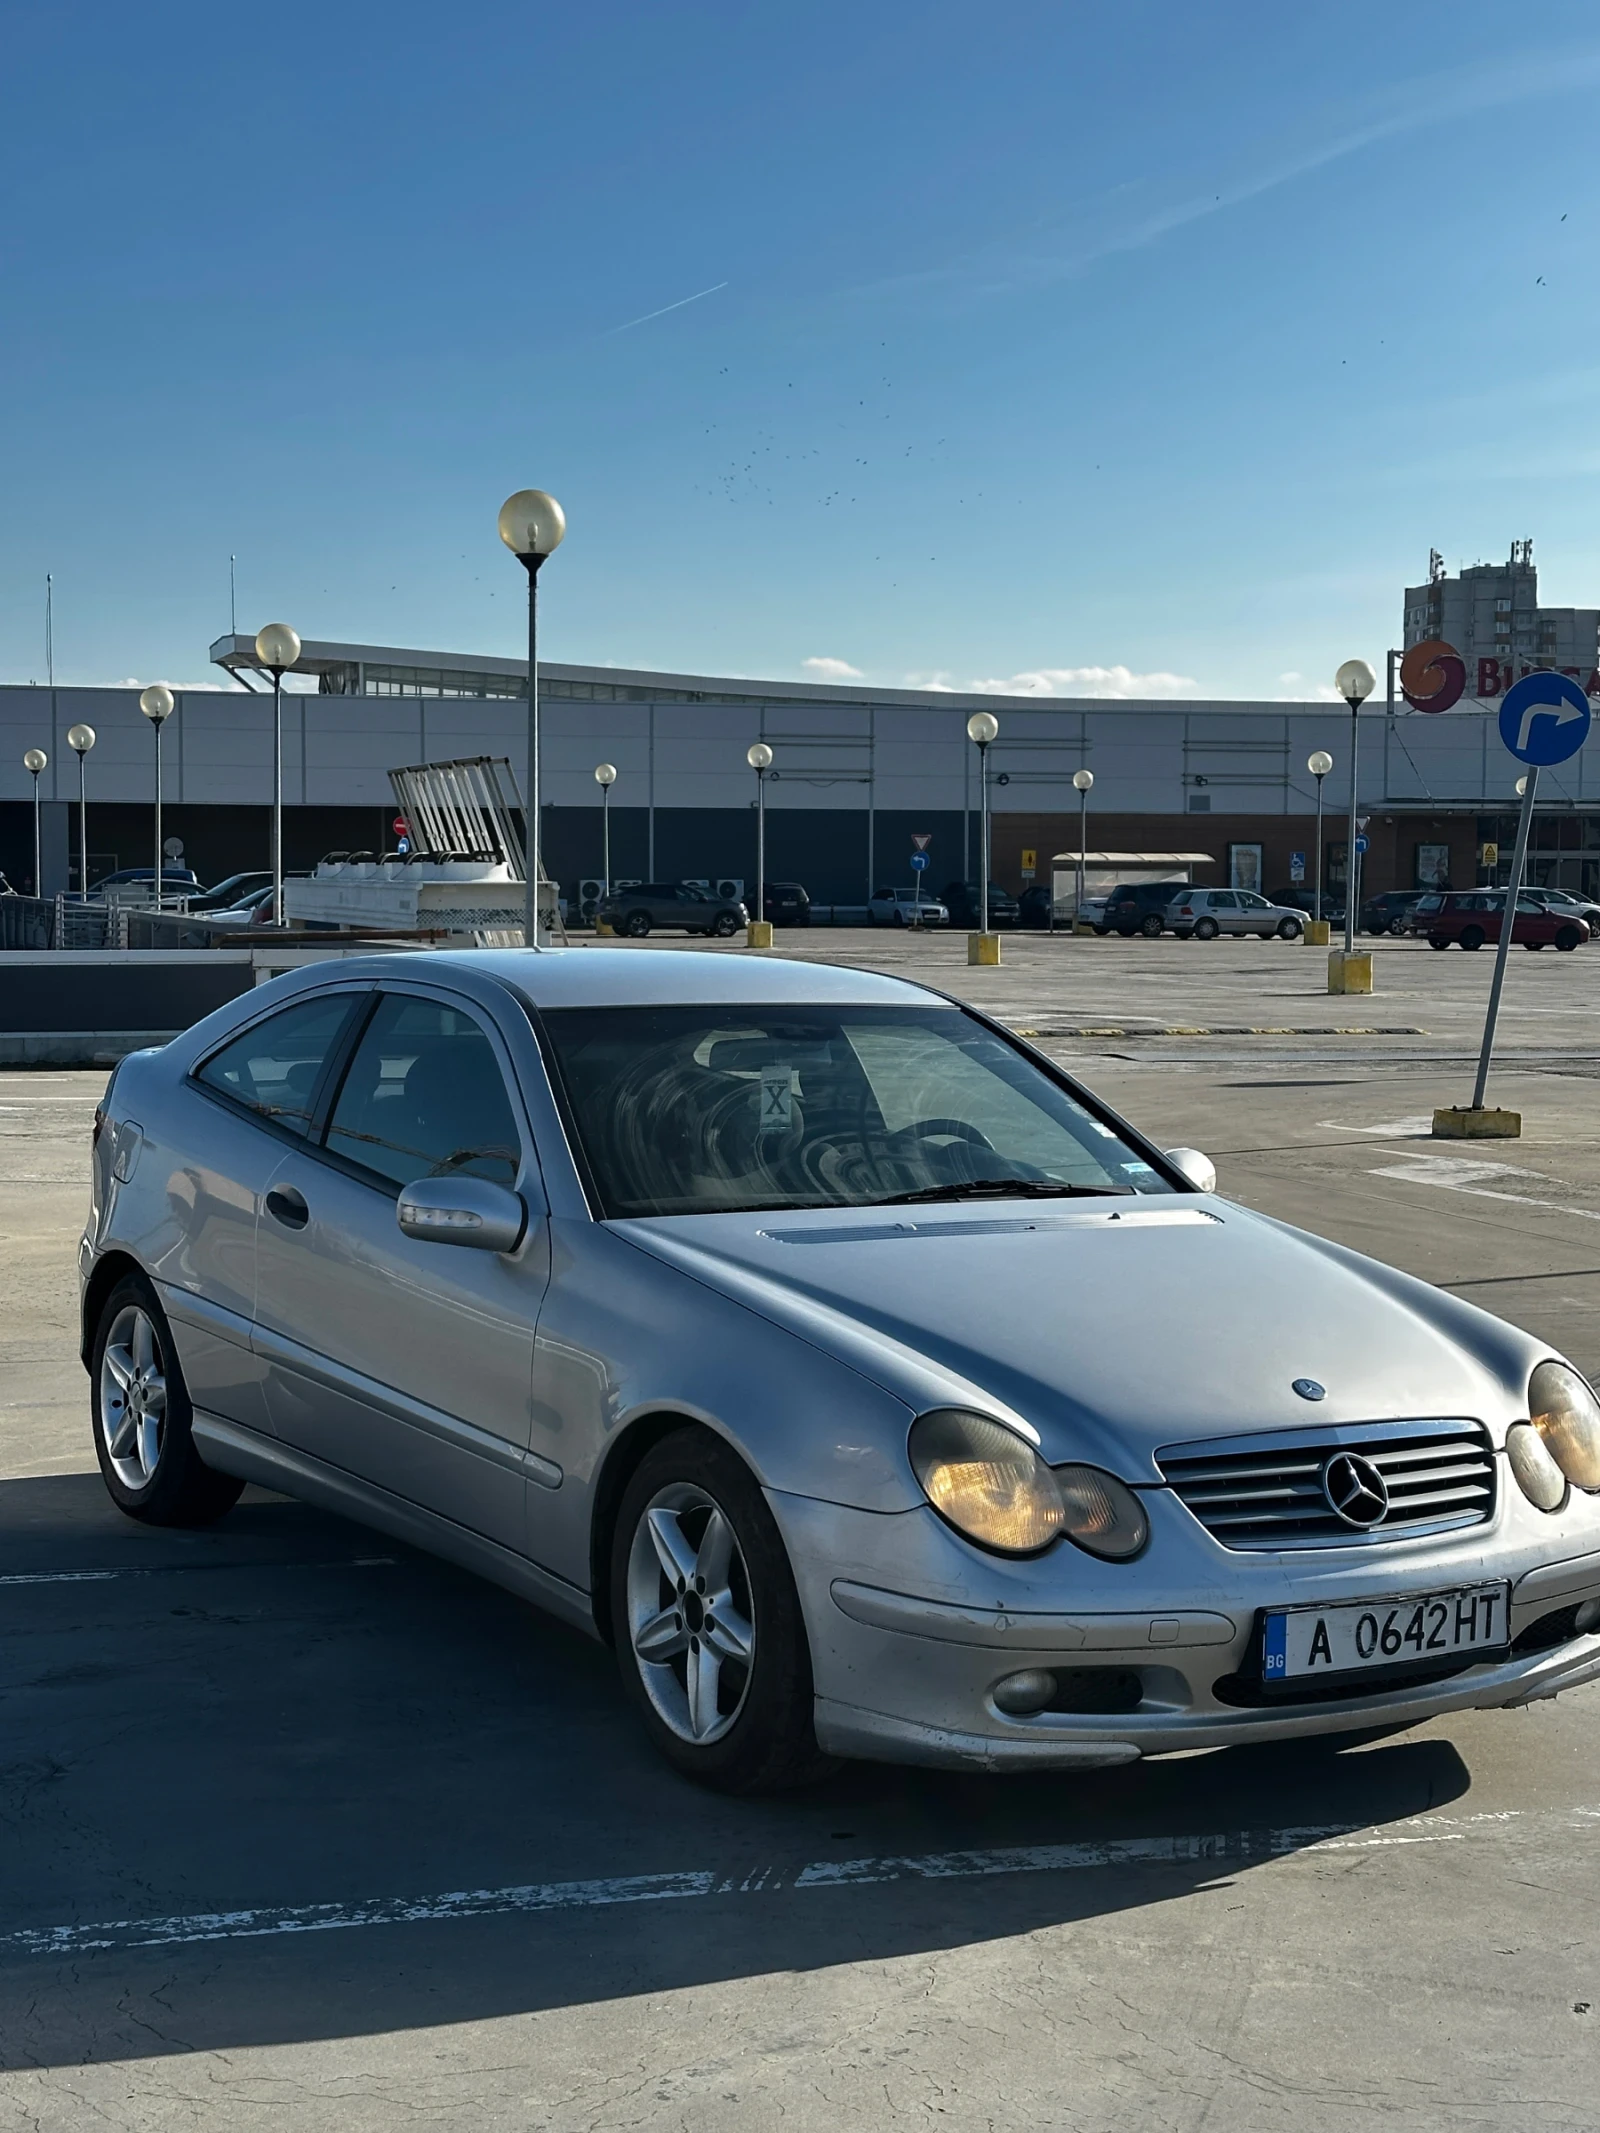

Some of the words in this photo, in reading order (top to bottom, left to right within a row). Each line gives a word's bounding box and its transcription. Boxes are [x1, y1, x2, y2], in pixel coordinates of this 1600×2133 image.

[764, 1086, 788, 1115] X
[1267, 1654, 1284, 1669] BG
[1308, 1618, 1332, 1666] A
